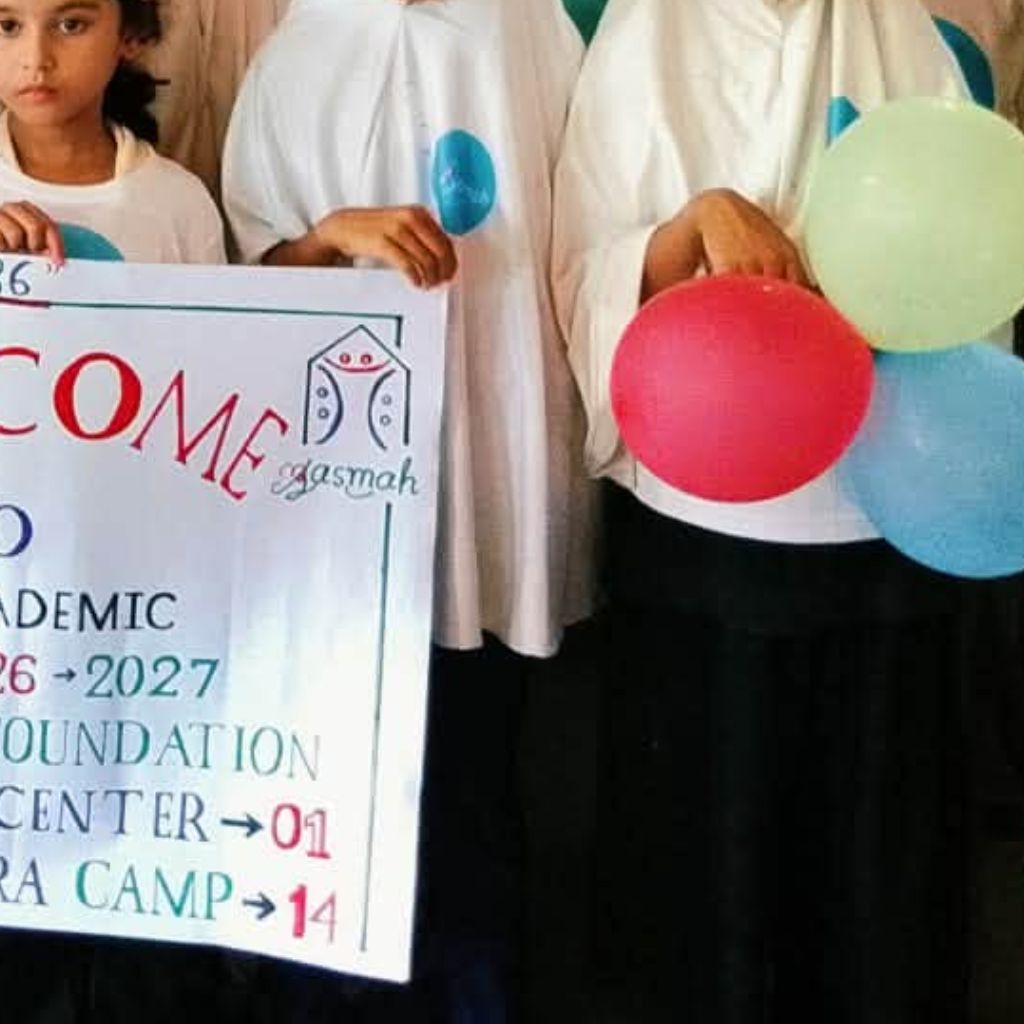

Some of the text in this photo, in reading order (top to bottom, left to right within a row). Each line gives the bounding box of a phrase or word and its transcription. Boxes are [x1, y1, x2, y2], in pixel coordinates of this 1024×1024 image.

[85, 654, 220, 699] 2027
[270, 802, 333, 860] 01
[74, 858, 235, 921] CAMP
[287, 882, 339, 945] 14
